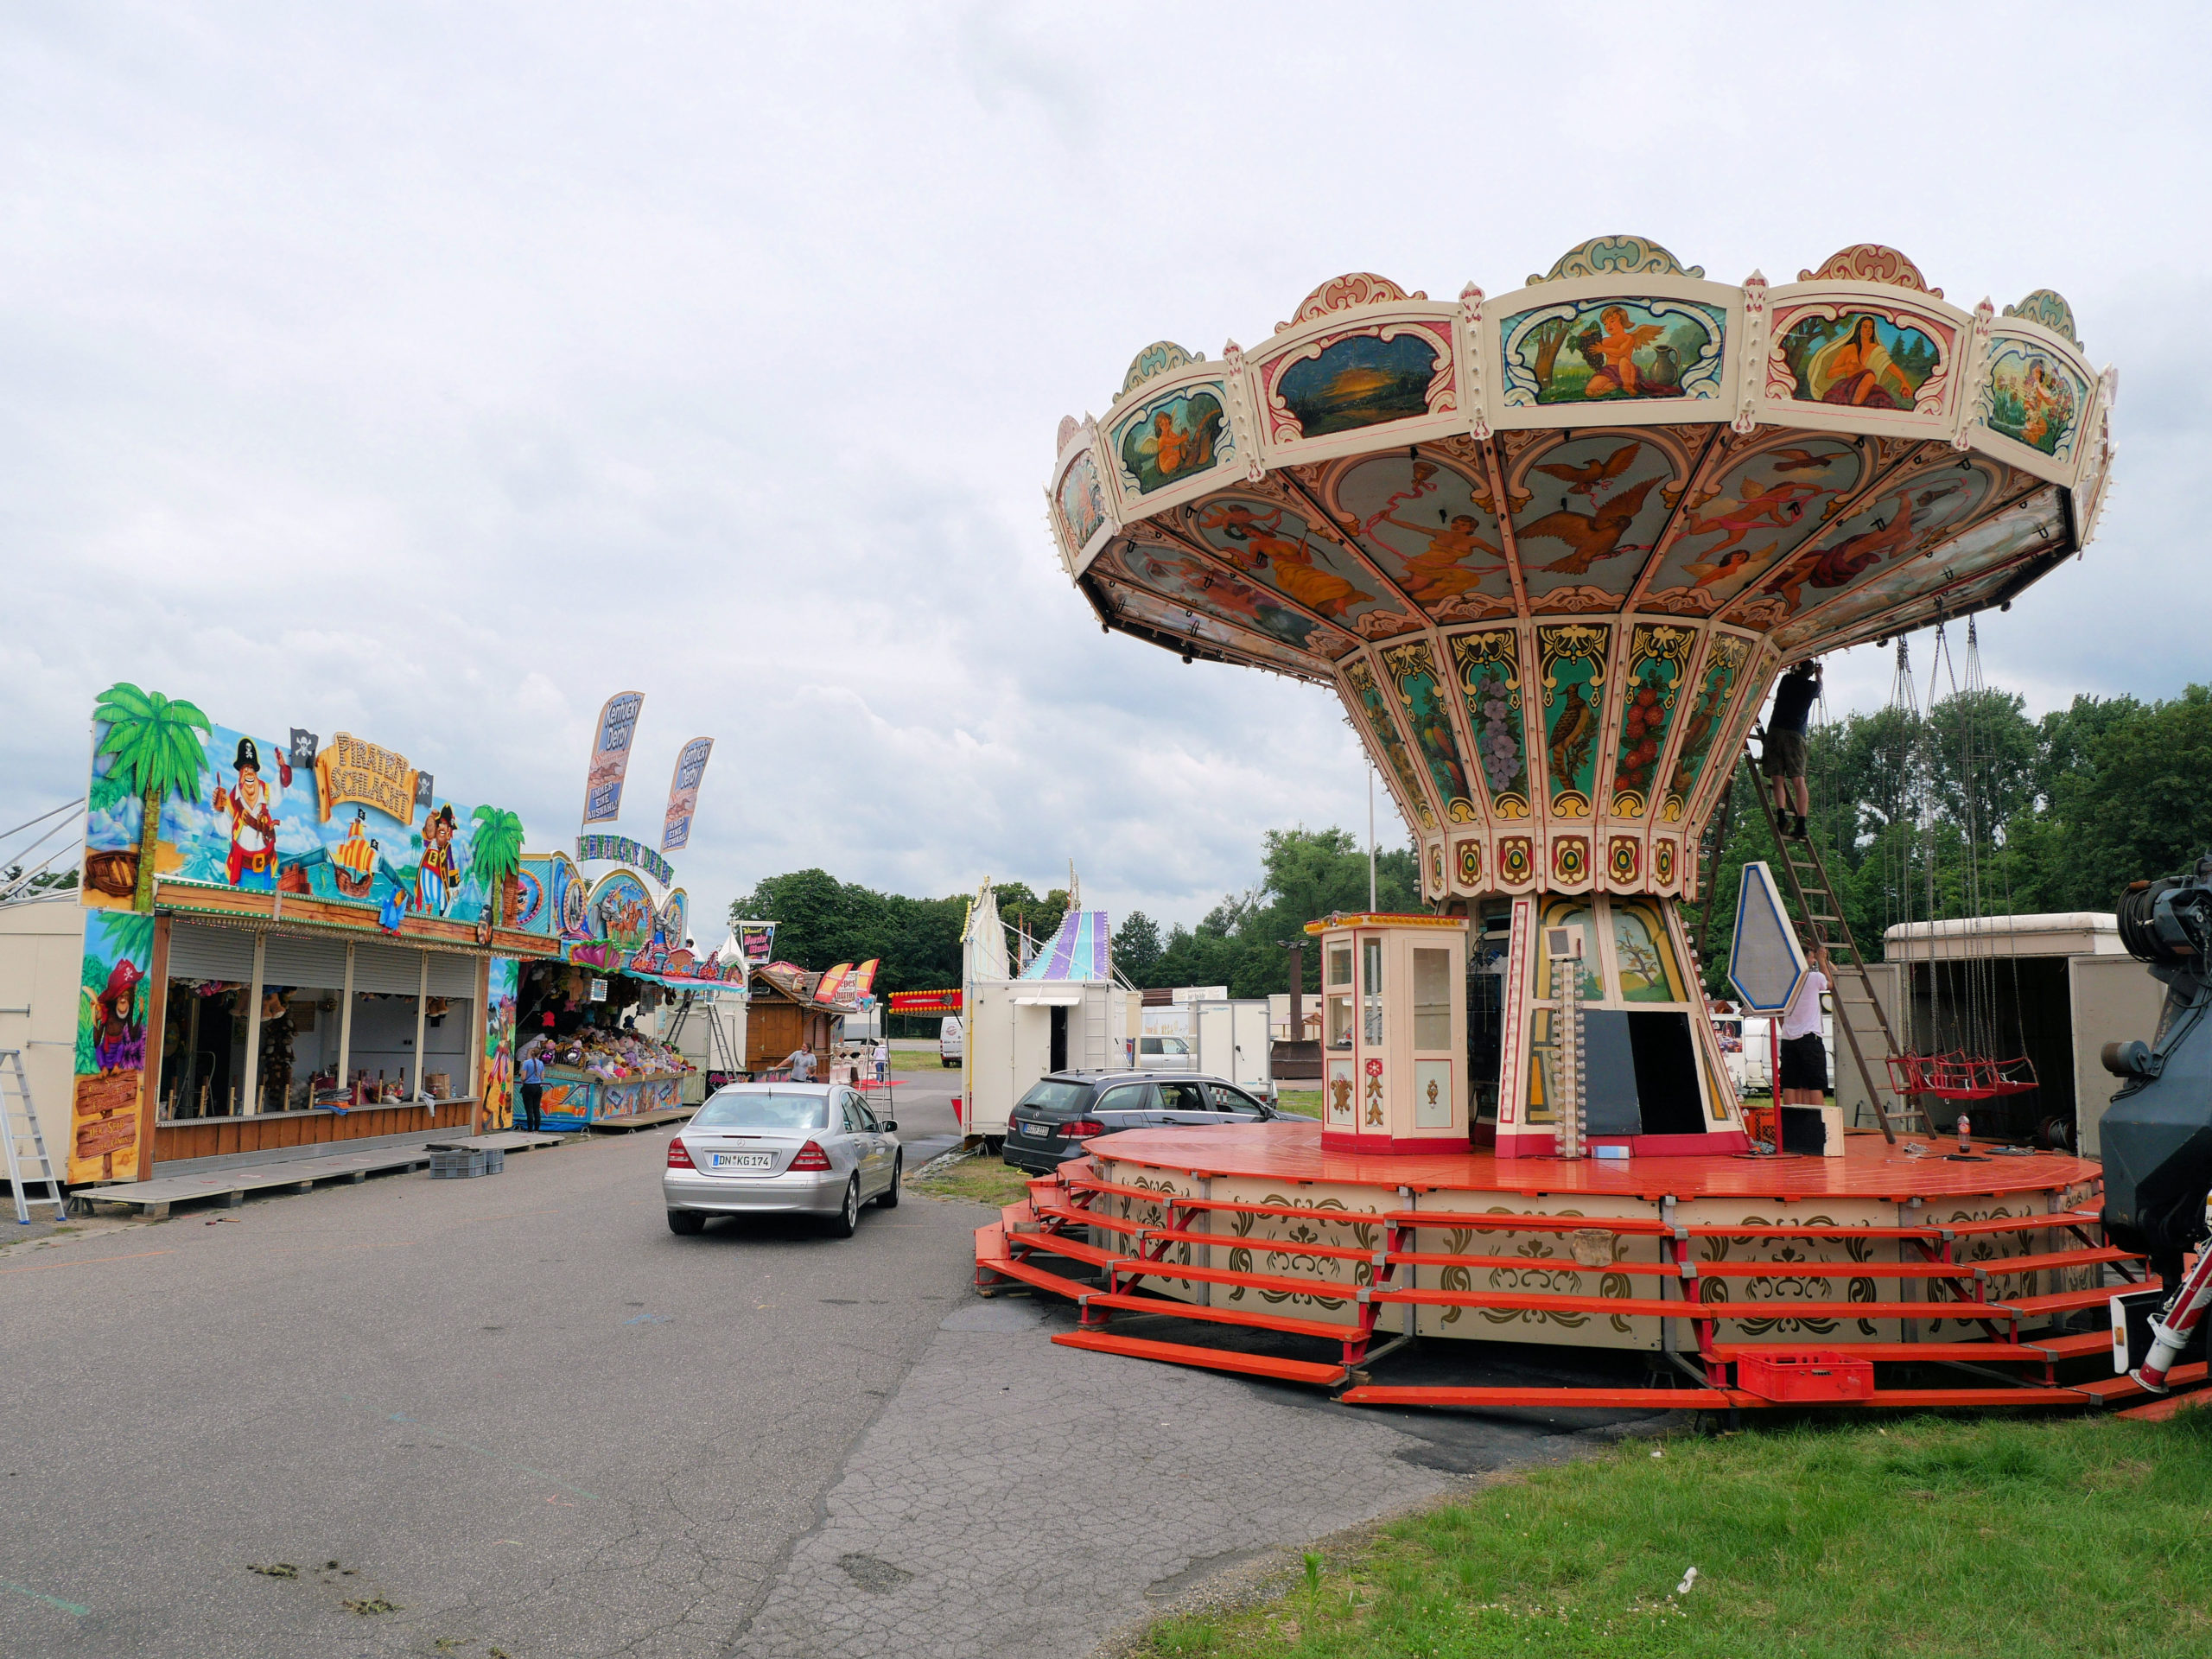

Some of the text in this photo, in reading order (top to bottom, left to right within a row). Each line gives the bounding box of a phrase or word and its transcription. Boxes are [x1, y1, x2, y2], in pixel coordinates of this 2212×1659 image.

[605, 694, 641, 728] Kentucky
[607, 723, 630, 751] Derby
[336, 734, 409, 787] PIRATEN
[681, 739, 711, 769] Kentucky
[591, 780, 613, 800] IMMER
[681, 766, 699, 790] Derby
[330, 766, 410, 819] SCHLACHT
[595, 793, 610, 809] EINE
[588, 800, 619, 821] AUSWAHL!
[669, 825, 683, 840] EINE
[575, 834, 675, 890] KENTUCKY DERBY
[835, 991, 855, 1001] hurros
[719, 1155, 768, 1166] DN KG 174
